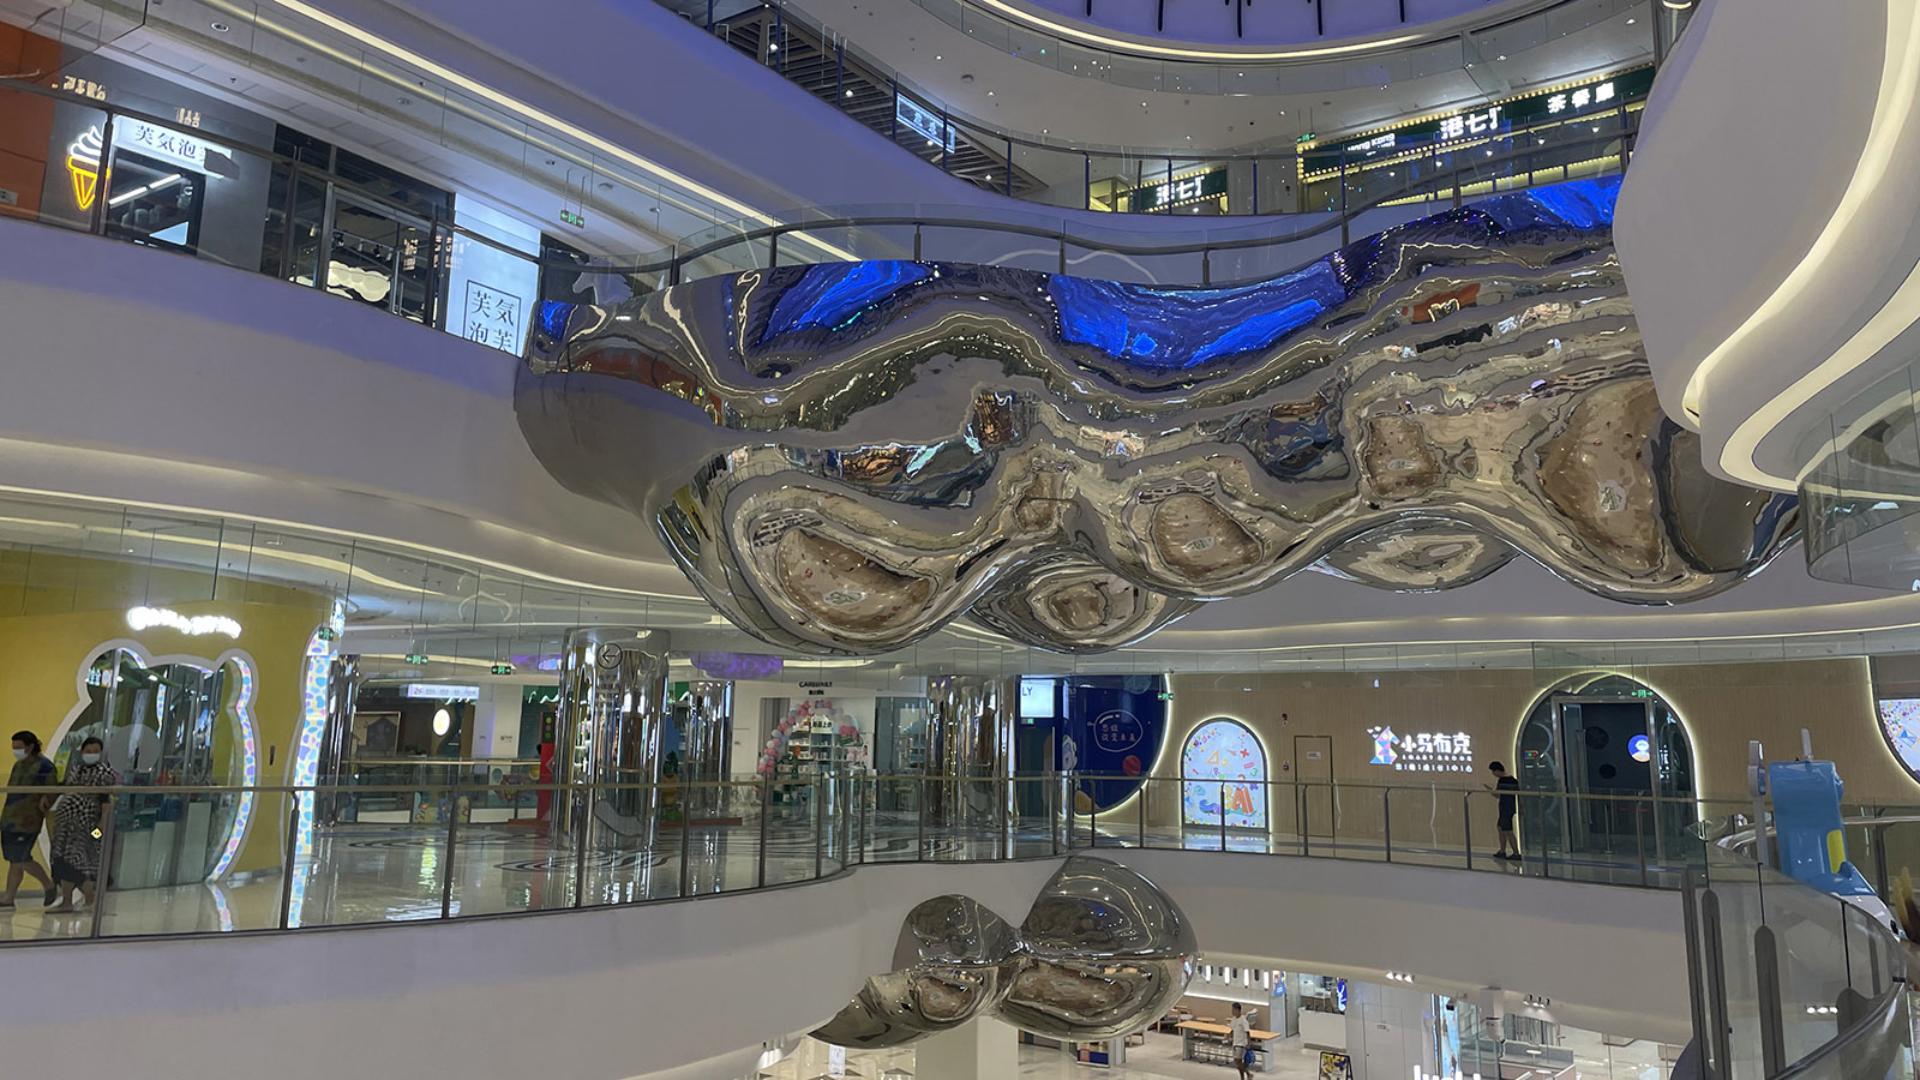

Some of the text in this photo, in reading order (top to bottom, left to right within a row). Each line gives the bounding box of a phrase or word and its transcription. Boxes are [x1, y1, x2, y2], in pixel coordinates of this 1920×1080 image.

[135, 123, 207, 163] 芙気泡
[1400, 732, 1473, 755] 小马布克
